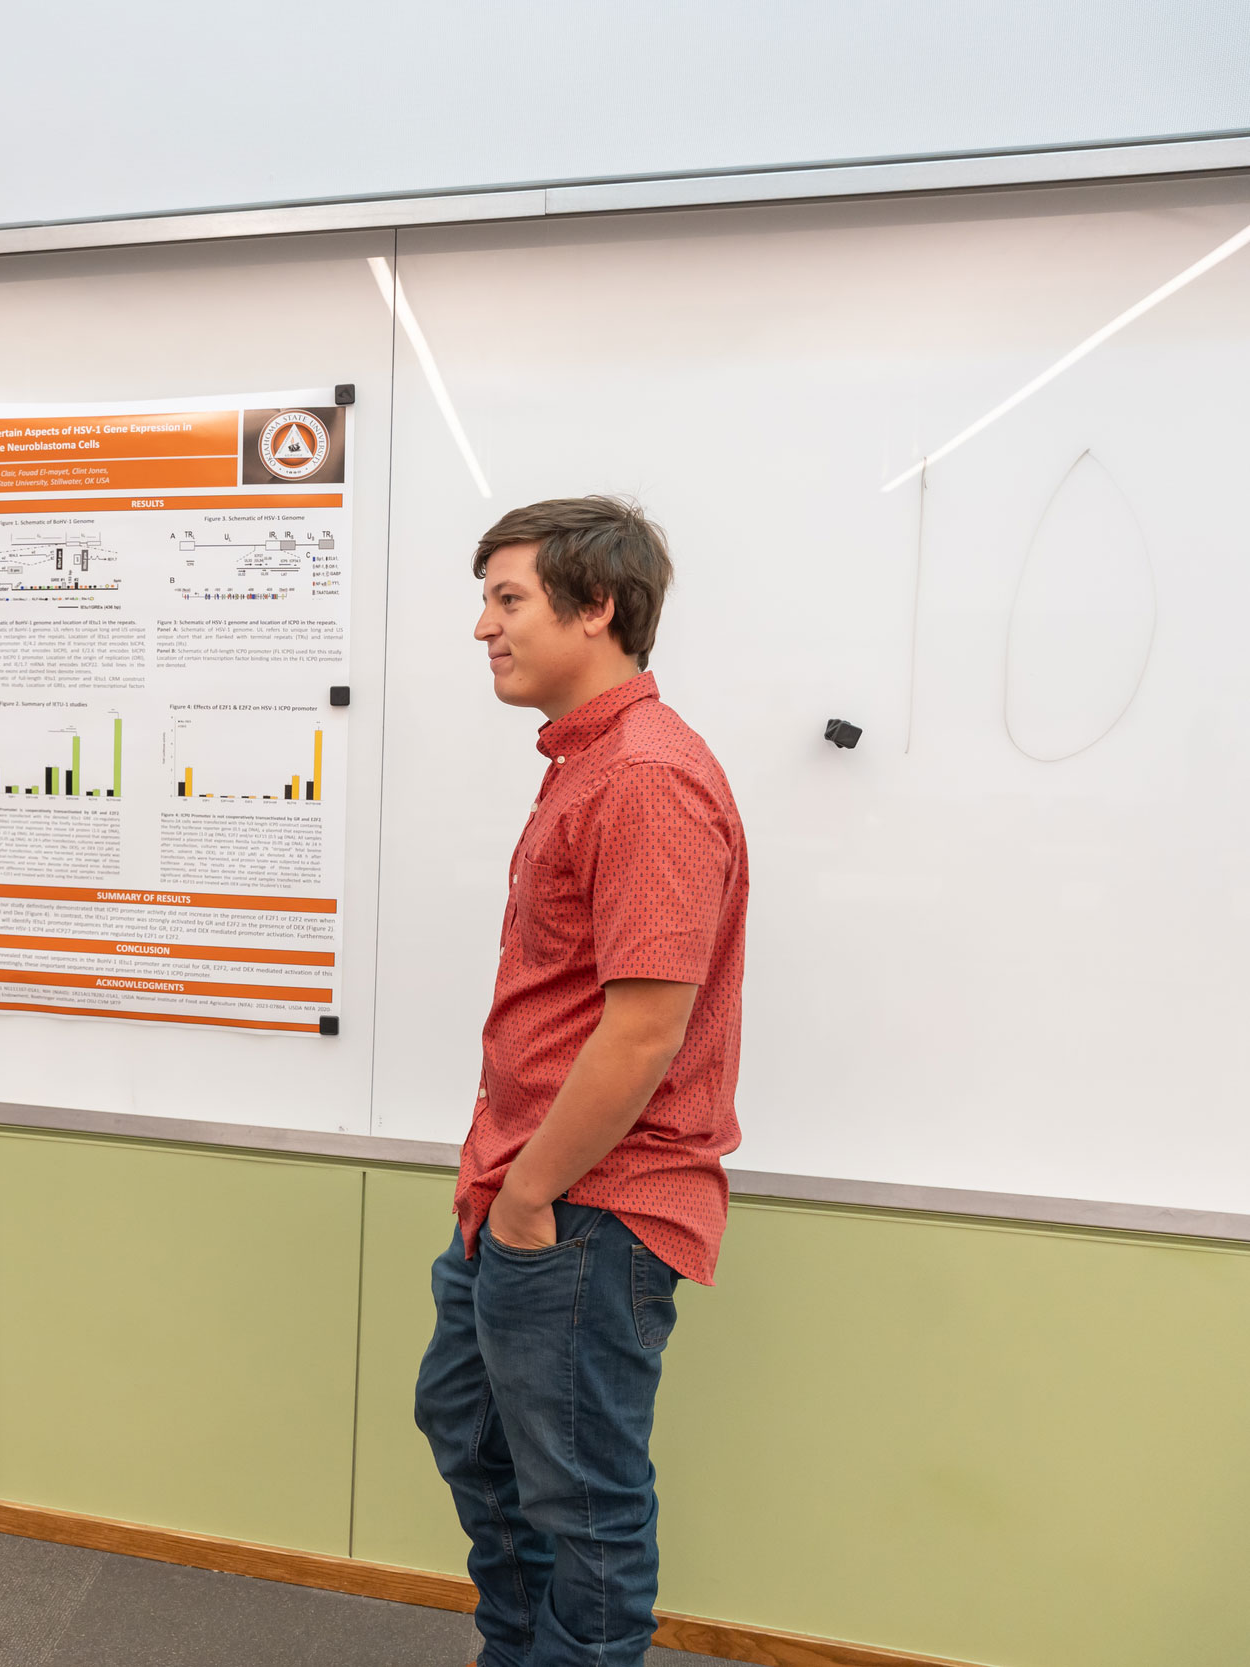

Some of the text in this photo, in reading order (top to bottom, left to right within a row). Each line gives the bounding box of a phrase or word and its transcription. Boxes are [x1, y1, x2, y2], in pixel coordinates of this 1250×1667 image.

[24, 427, 60, 436] Aspects
[61, 426, 71, 435] of
[73, 425, 101, 434] HSV-1
[103, 424, 128, 433] Gene
[130, 422, 181, 434] Expression
[183, 422, 192, 432] in
[7, 442, 76, 451] Neuroblastoma
[78, 439, 99, 449] Cells
[263, 420, 281, 466] OKLAHOMA
[309, 420, 325, 466] UNIVERSITY
[131, 500, 164, 508] RESULTS
[97, 892, 142, 901] SUMMARY
[157, 895, 191, 904] RESULTS
[116, 945, 170, 954] CONCLUSION
[96, 979, 184, 992] ACKNOWLEDGMENTS
